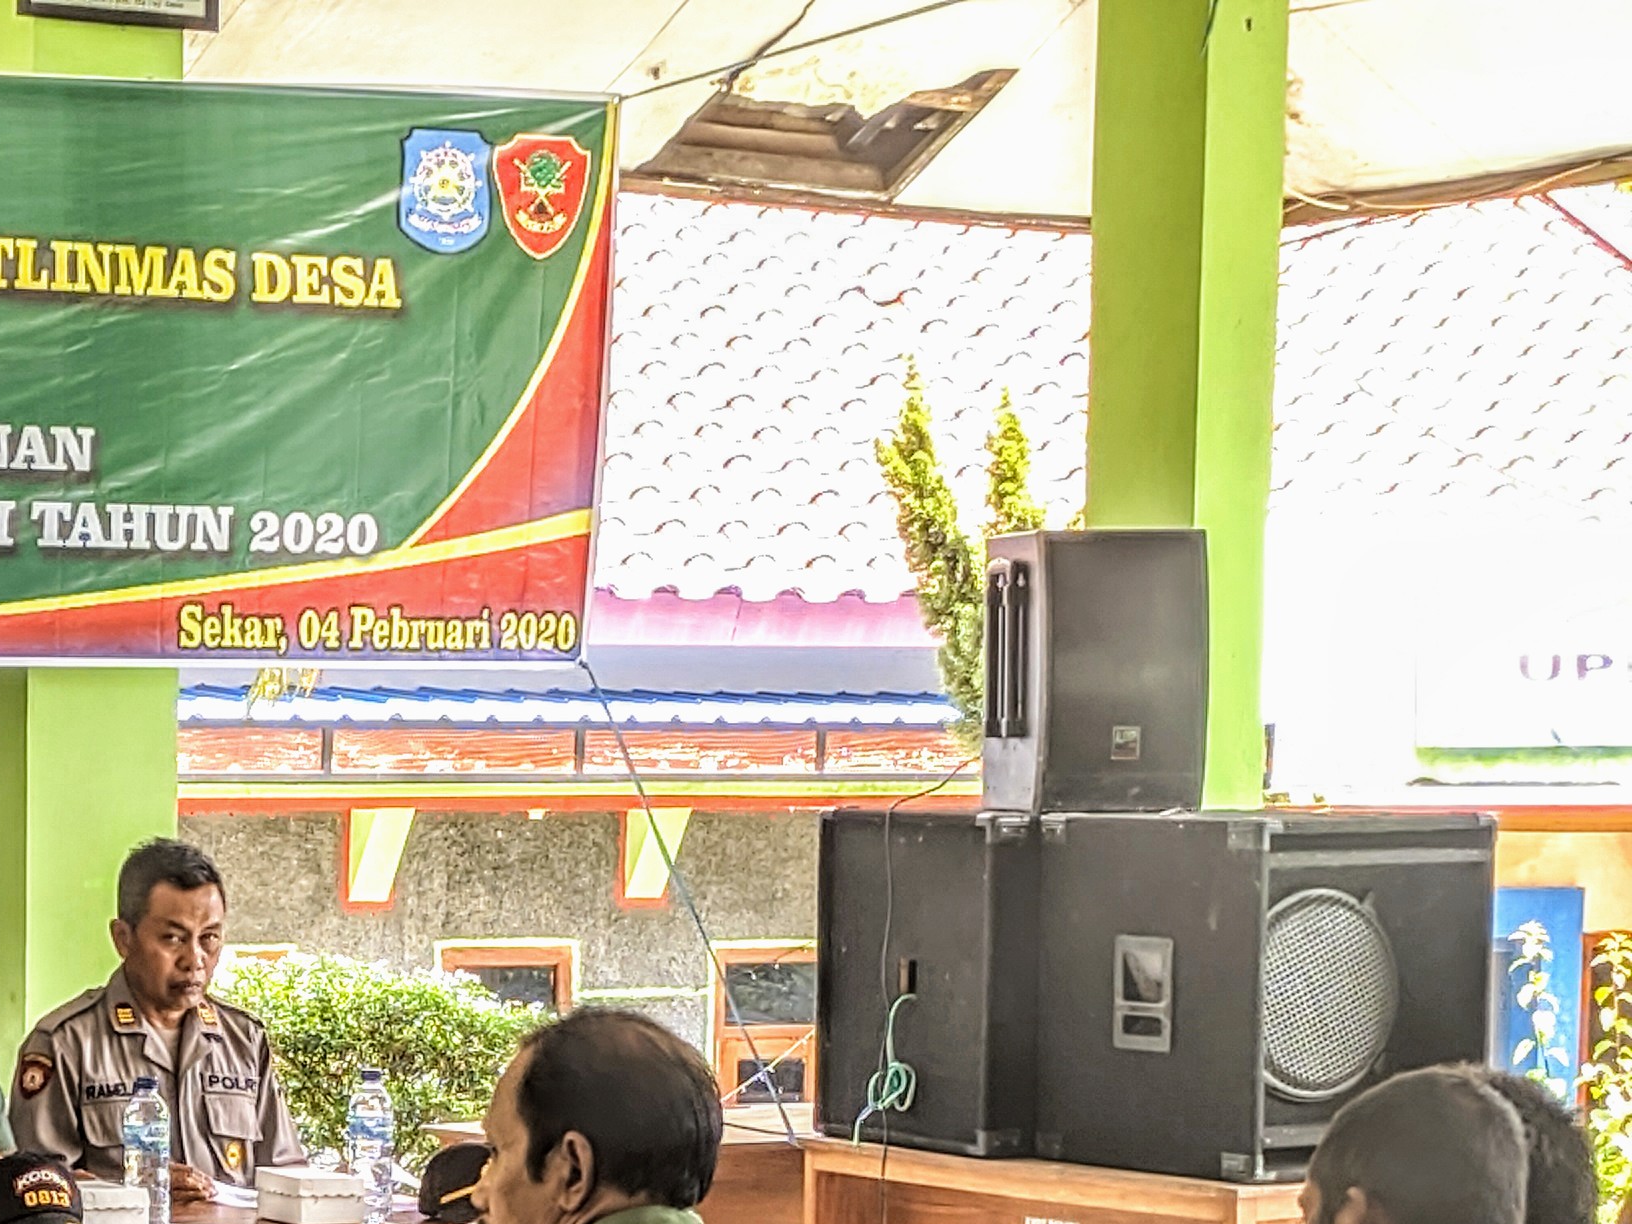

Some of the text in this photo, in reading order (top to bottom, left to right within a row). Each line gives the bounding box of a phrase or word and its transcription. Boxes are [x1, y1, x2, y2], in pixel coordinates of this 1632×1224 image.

[250, 251, 402, 309] DESA
[30, 502, 235, 553] TAHUN
[249, 510, 379, 555] 2020
[178, 603, 577, 657] Sekar, 04 Pebruari 2020
[1519, 653, 1632, 681] UP
